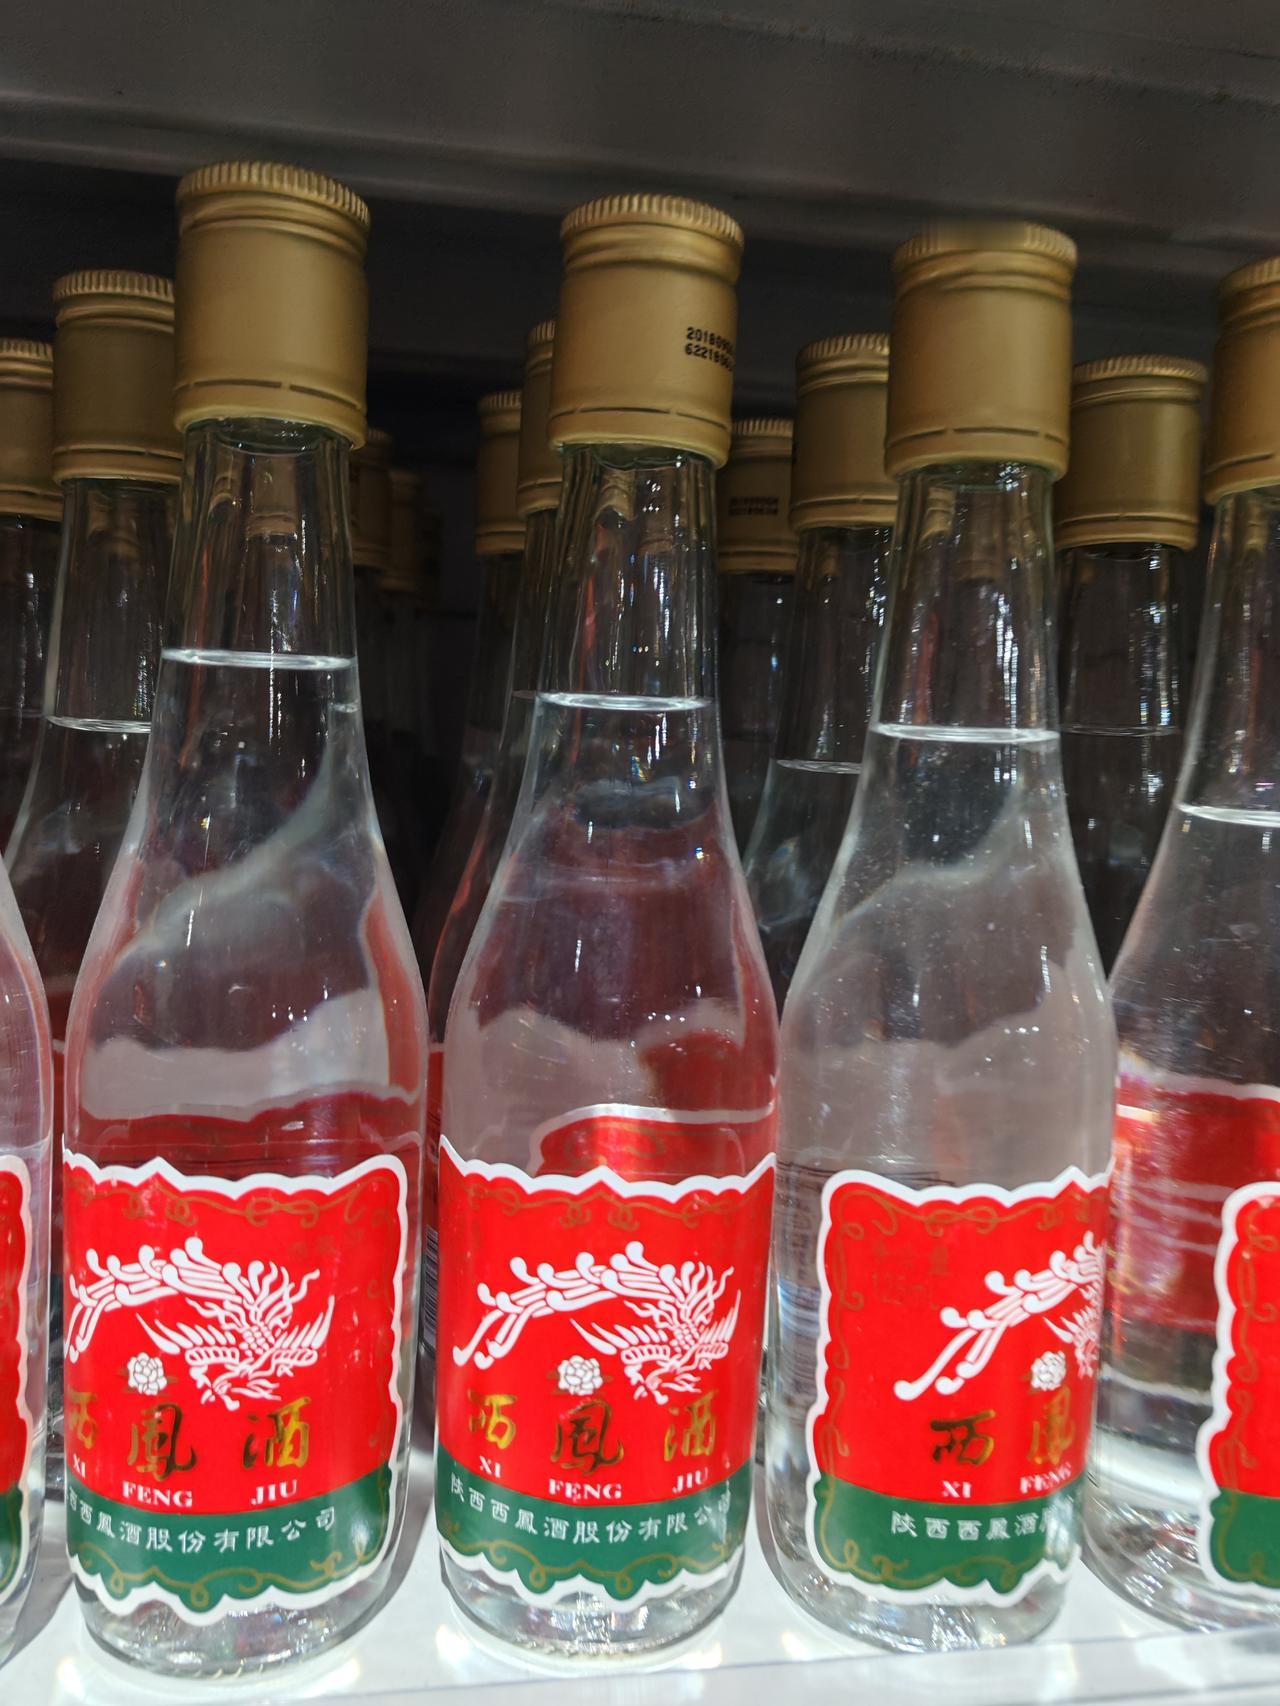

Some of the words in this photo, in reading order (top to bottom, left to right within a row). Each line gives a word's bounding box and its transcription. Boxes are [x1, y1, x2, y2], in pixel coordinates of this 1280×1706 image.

[73, 1453, 86, 1478] XI
[122, 1481, 193, 1508] FENG
[251, 1480, 298, 1505] JIU
[479, 1455, 501, 1478] XI
[549, 1478, 622, 1500] FENG
[672, 1467, 709, 1493] JIU
[942, 1480, 972, 1499] XI
